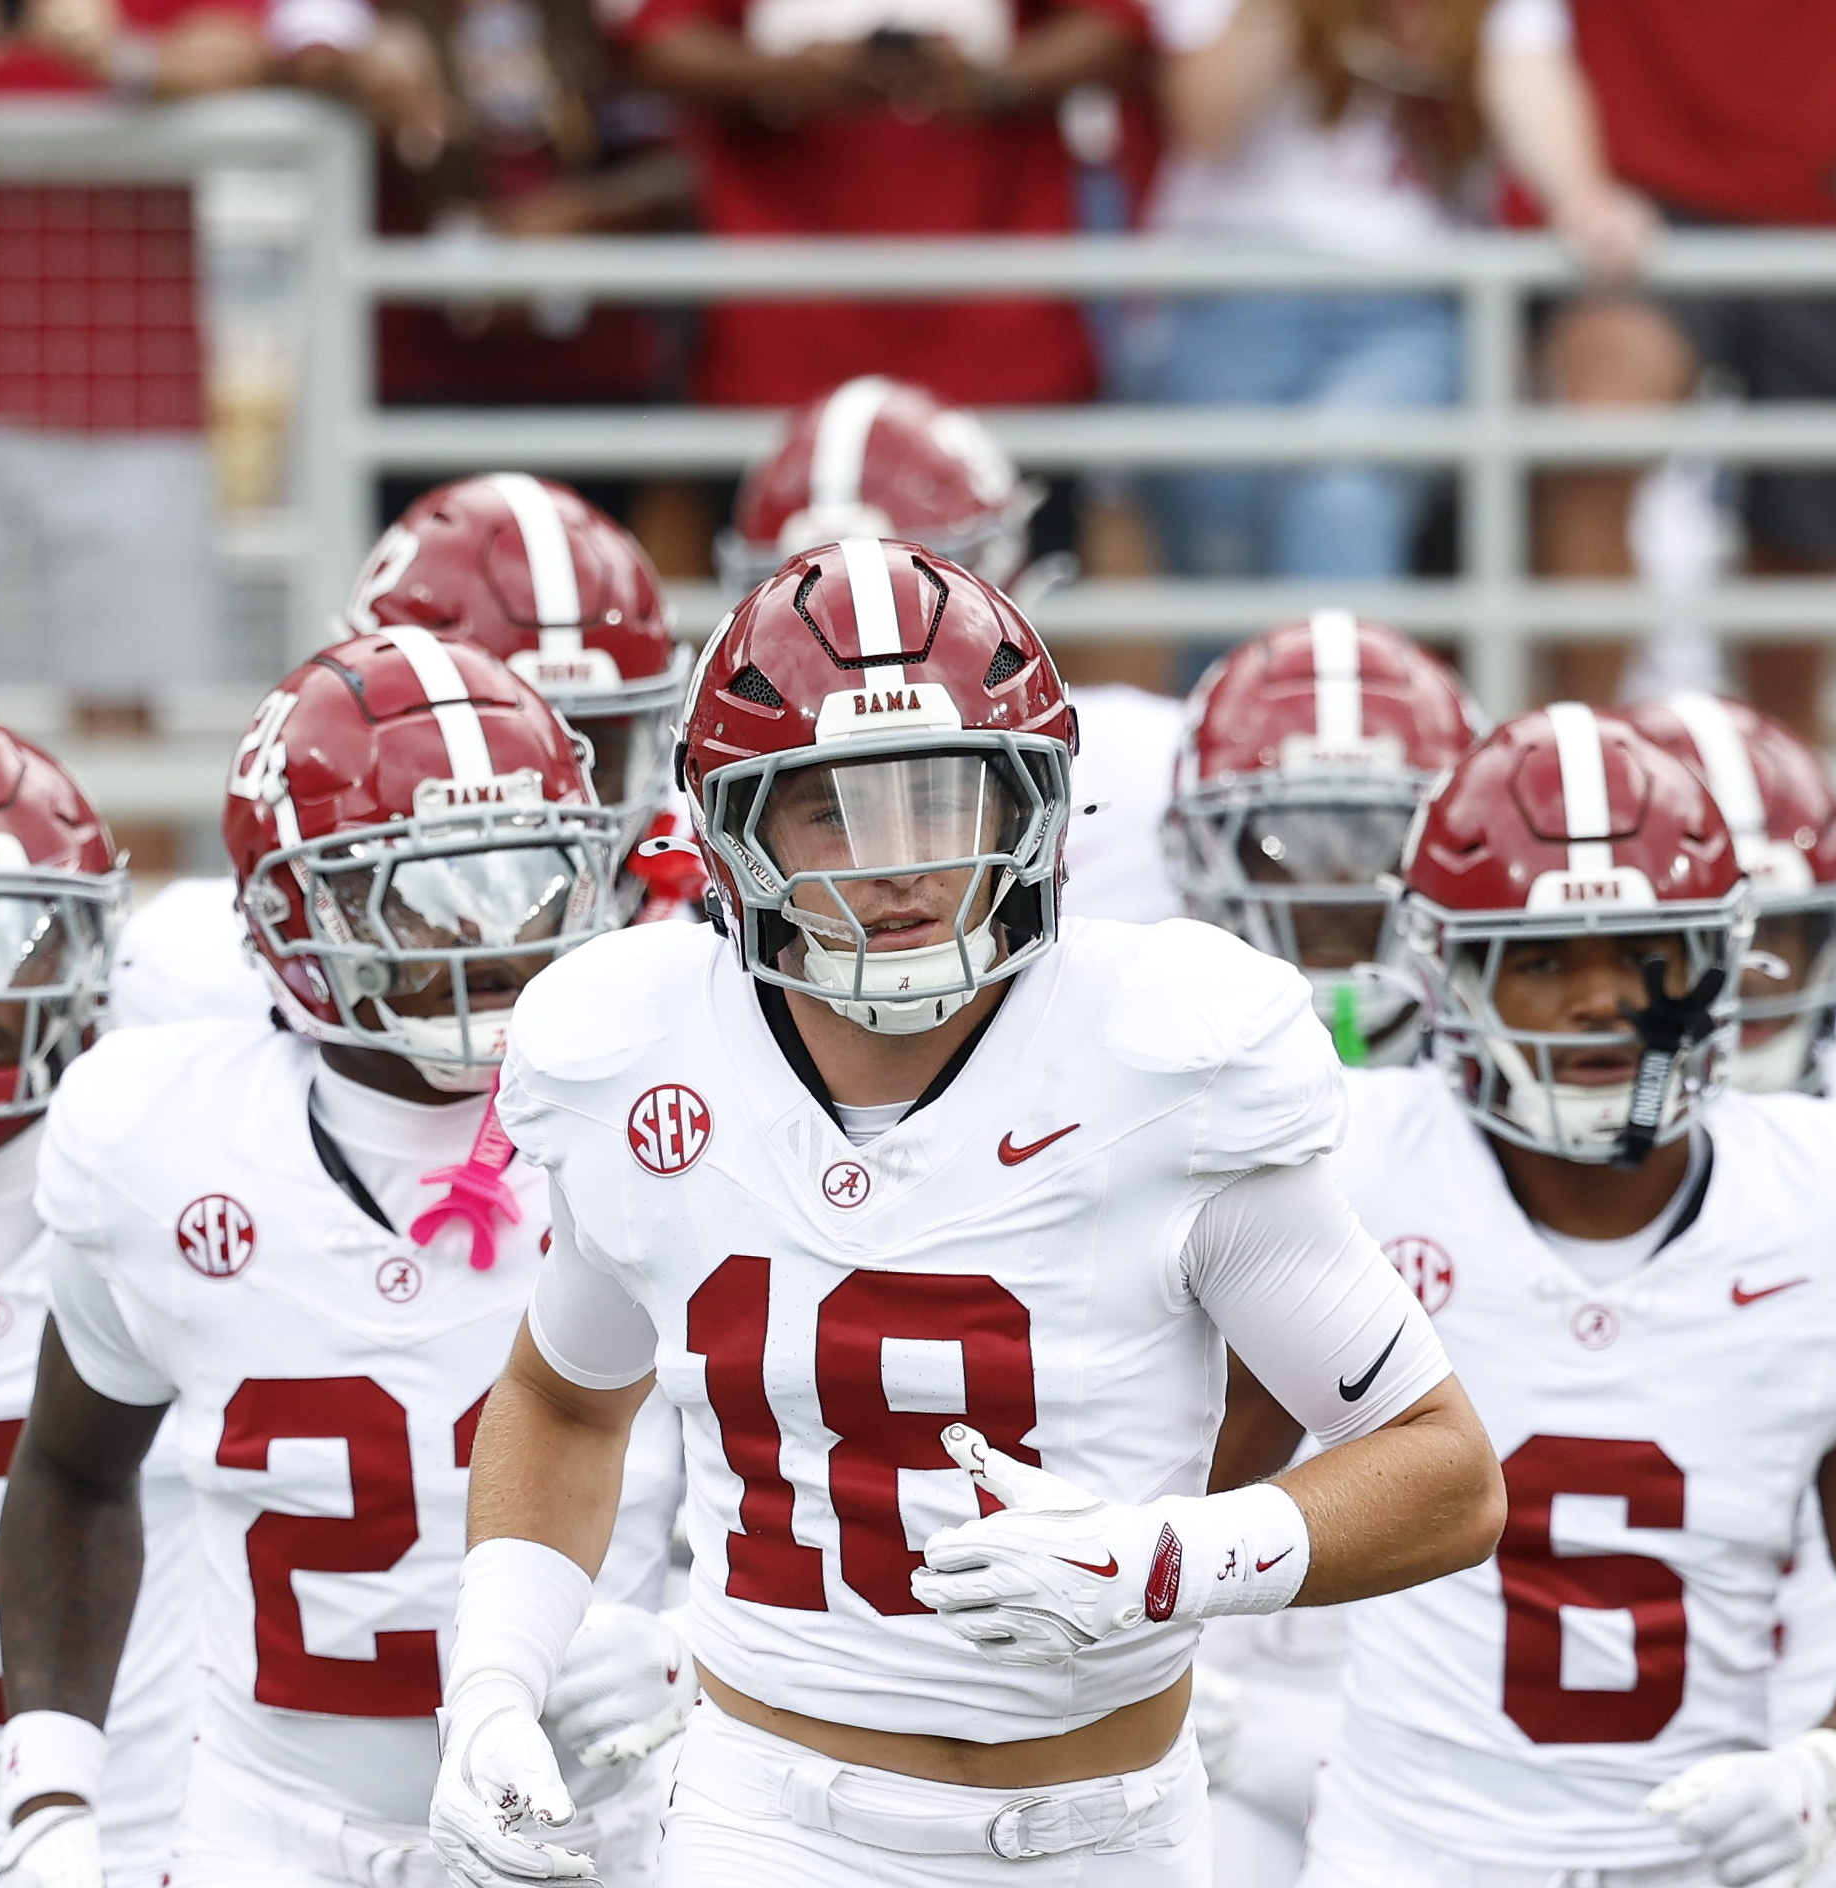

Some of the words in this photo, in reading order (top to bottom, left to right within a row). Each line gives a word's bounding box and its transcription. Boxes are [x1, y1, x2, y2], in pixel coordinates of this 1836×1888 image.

[853, 690, 921, 717] BAMA
[446, 785, 505, 806] BAMA
[628, 1085, 711, 1173] SEC
[177, 1195, 256, 1277] SEC
[686, 1254, 1042, 1616] 18
[1496, 1434, 1687, 1745] 6
